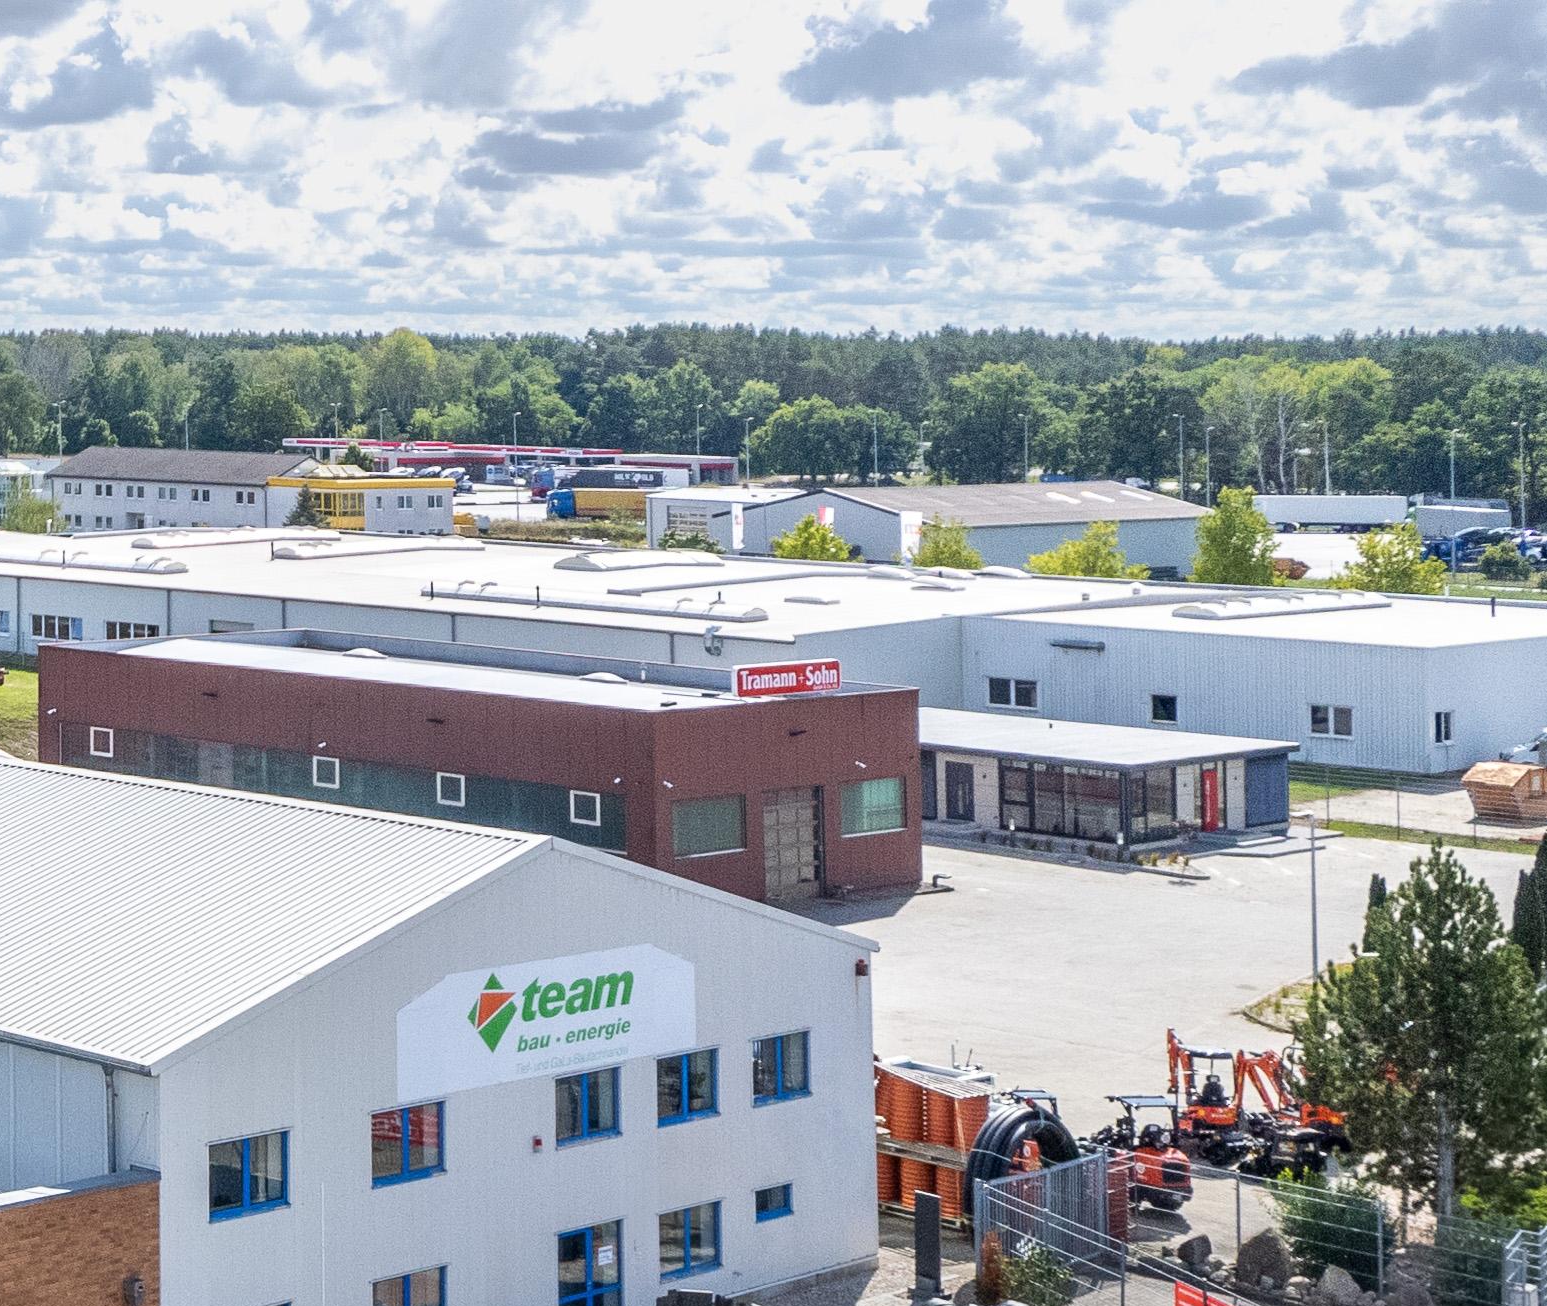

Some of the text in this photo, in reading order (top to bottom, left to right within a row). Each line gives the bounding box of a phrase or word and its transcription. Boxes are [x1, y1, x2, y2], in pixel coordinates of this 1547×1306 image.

[740, 669, 797, 691] Tramann
[806, 664, 838, 686] Sohn
[520, 970, 635, 1023] team
[516, 1034, 551, 1053] bau
[565, 1017, 632, 1044] energie
